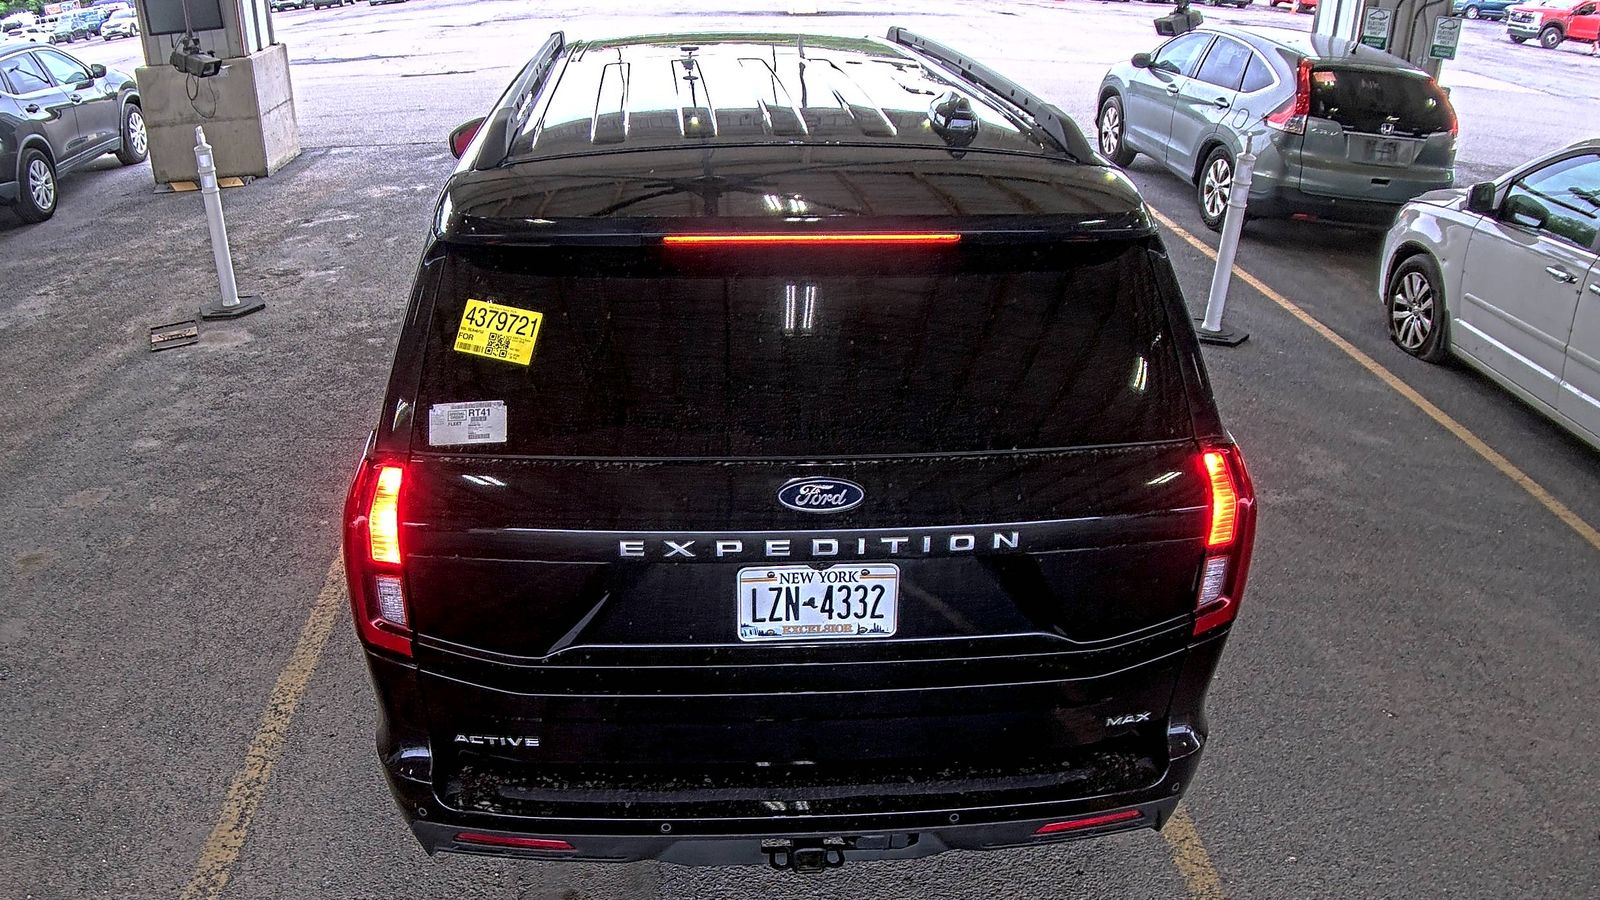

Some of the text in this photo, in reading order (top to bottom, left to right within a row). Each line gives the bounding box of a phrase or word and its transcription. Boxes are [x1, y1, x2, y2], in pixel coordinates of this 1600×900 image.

[465, 306, 538, 338] 4379721
[458, 332, 474, 341] FOR
[468, 408, 491, 417] RT41
[795, 484, 848, 506] Ford
[619, 531, 1020, 557] EXPEDITION
[779, 570, 860, 584] NEW YORK
[752, 584, 886, 623] LZN 4332
[782, 623, 854, 635] EXCELSIOR
[1105, 711, 1152, 727] MAX
[454, 734, 540, 747] ACTIVE
